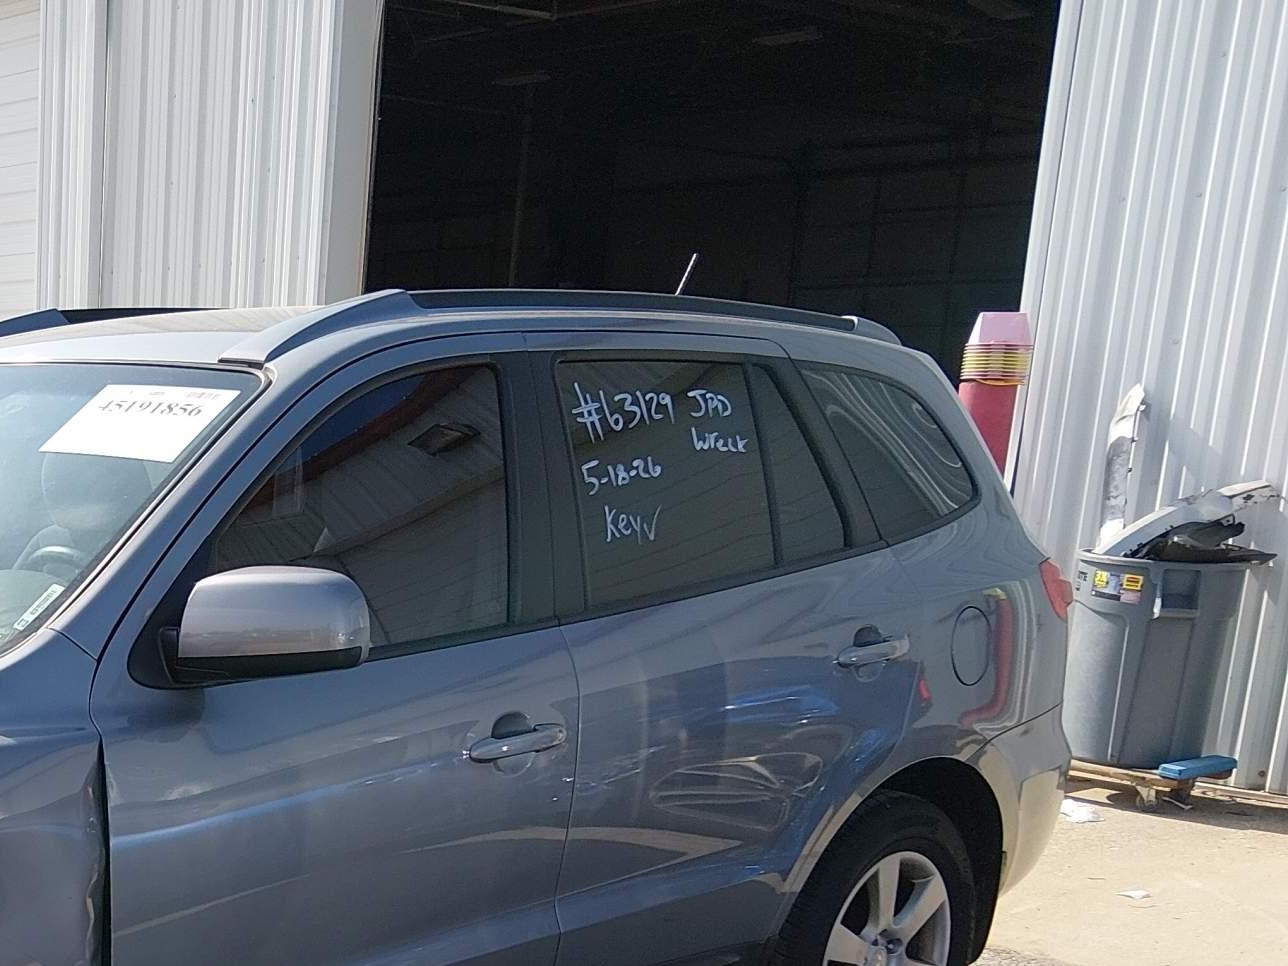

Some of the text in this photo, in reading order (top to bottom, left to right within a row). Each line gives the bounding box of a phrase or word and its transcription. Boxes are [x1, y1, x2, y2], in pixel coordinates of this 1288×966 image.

[98, 399, 203, 417] 45191856
[571, 382, 675, 443] #63129
[581, 456, 662, 496] 5-18-26
